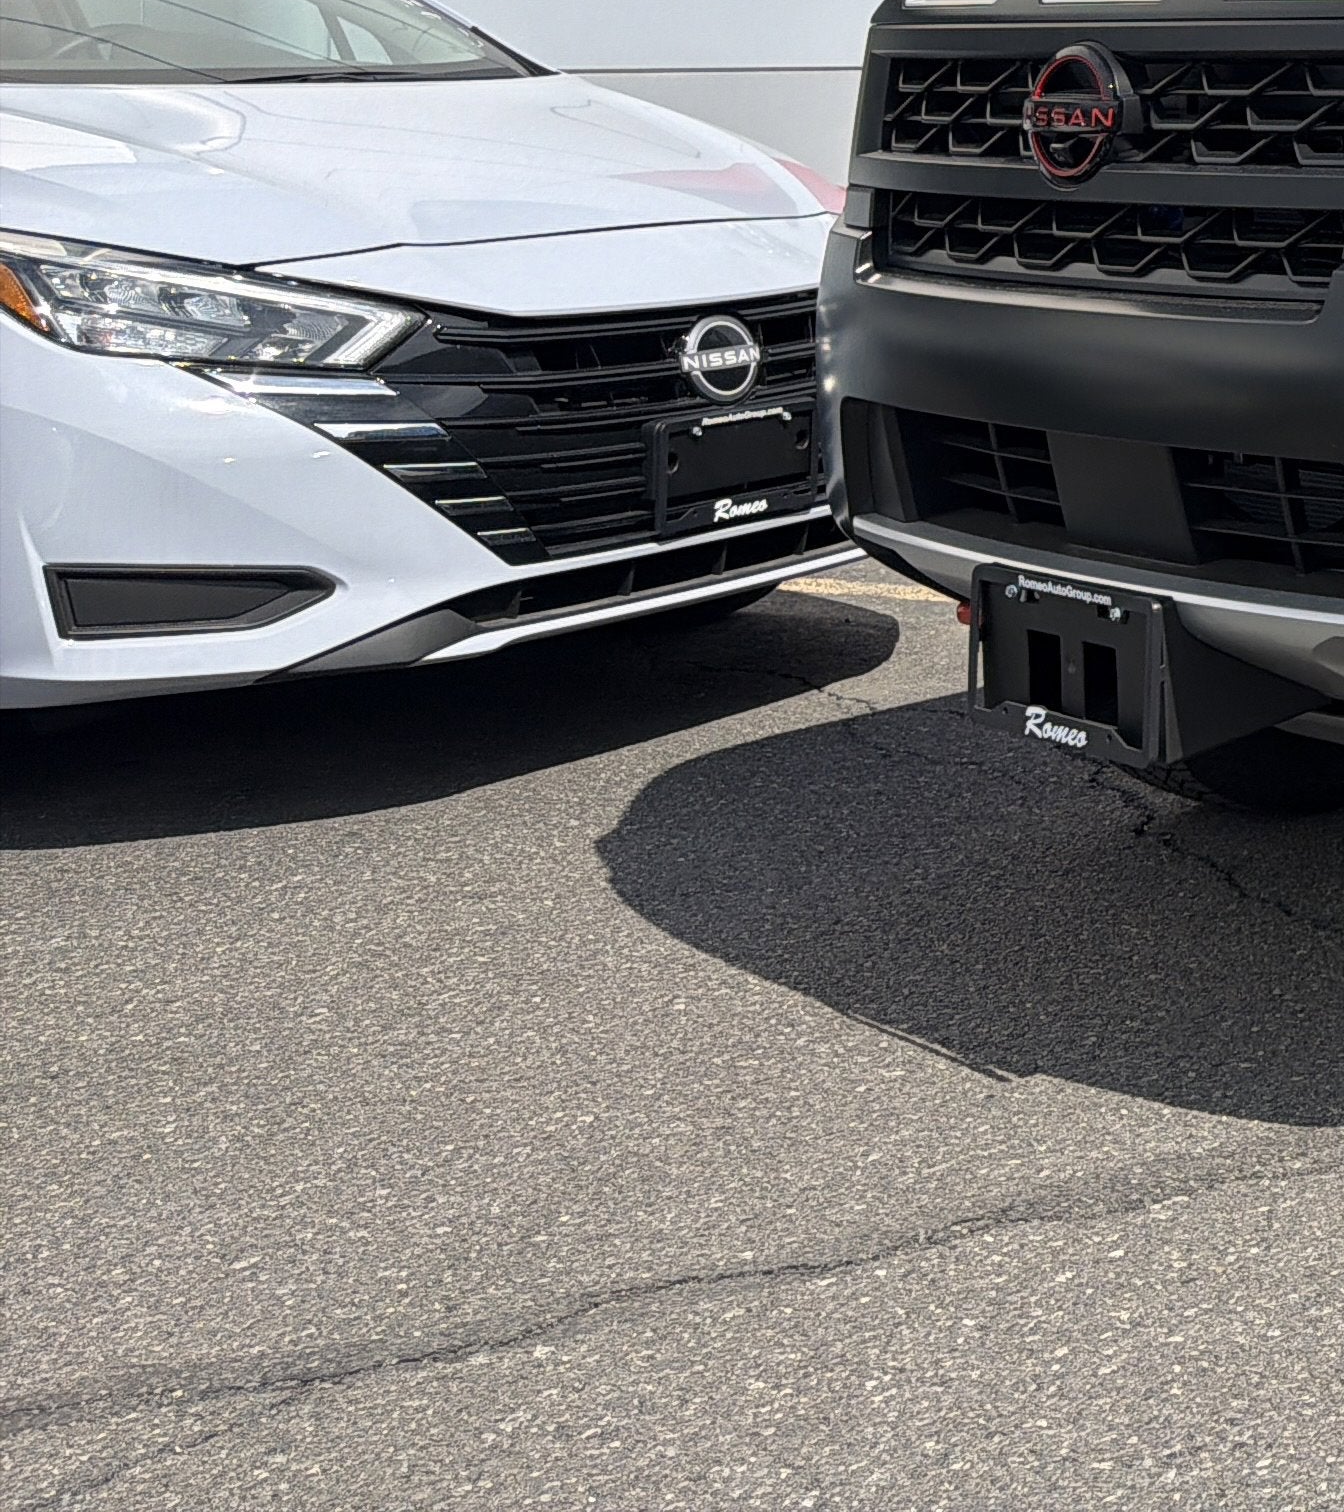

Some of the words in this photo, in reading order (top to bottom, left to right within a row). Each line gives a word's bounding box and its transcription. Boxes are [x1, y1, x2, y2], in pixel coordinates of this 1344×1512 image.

[683, 346, 760, 371] NISSAN
[713, 497, 768, 523] Romeo
[1018, 575, 1112, 606] RomeoAutoGroup.com
[1024, 705, 1088, 748] Romeo
